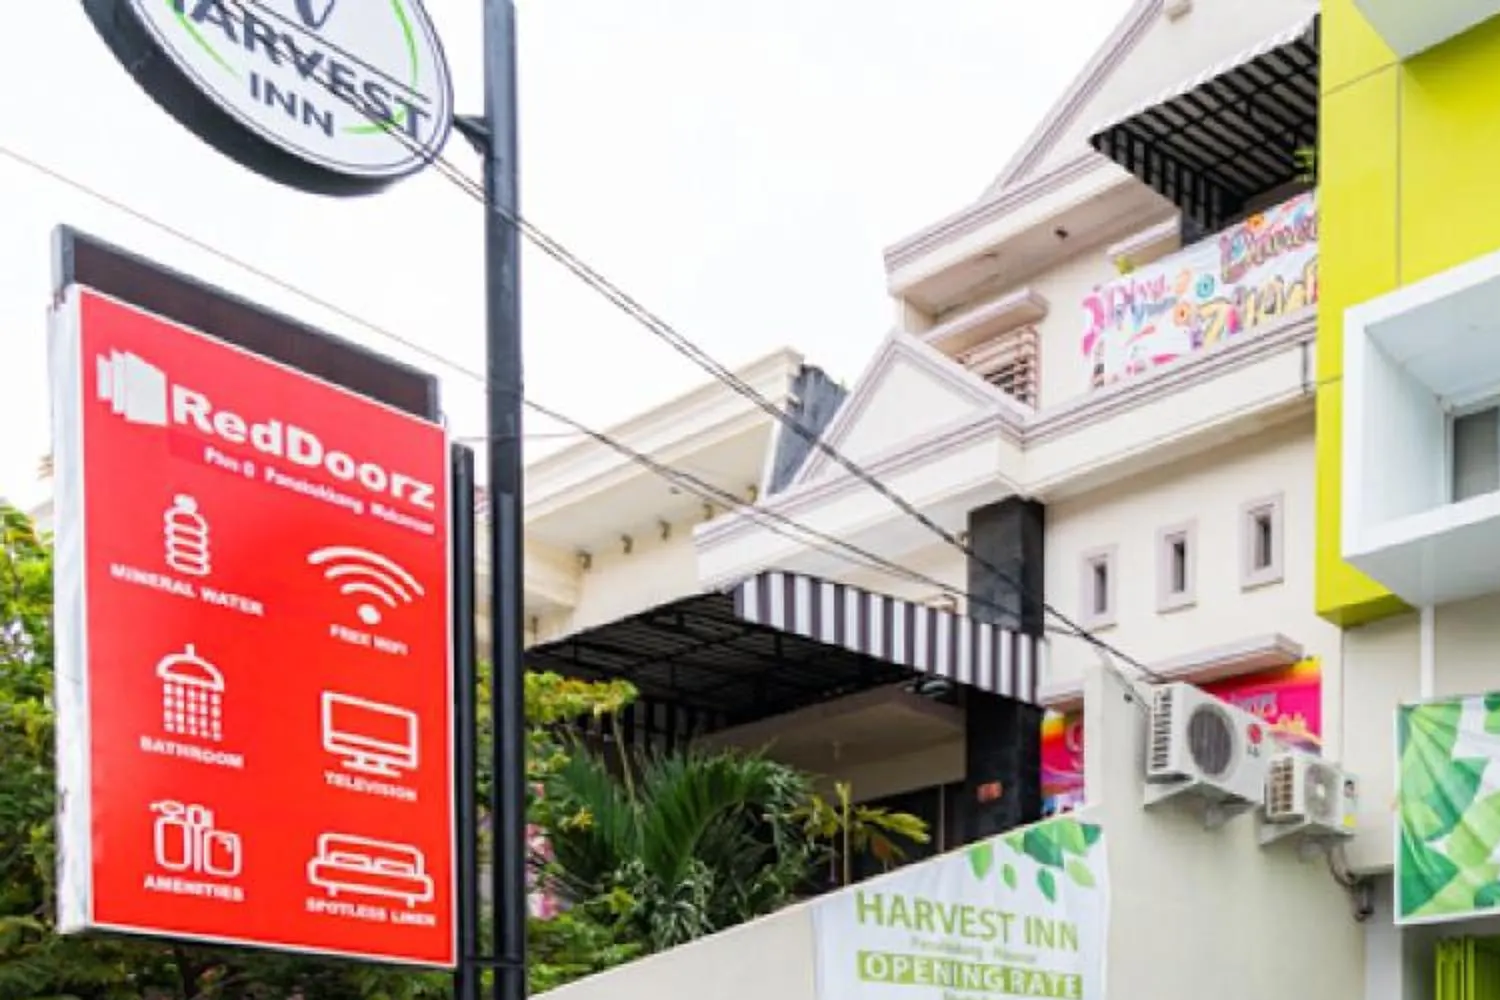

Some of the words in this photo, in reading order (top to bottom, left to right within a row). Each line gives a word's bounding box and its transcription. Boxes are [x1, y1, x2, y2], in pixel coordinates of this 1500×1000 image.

[250, 71, 335, 138] INN
[172, 383, 436, 512] RedDoorz
[110, 562, 197, 599] MINERAL
[201, 586, 266, 617] WATER
[329, 623, 371, 647] FREE
[139, 735, 245, 769] BATHROOM
[323, 770, 418, 802] TELEVISION
[144, 874, 245, 902] AMENITIES
[305, 897, 387, 923] SPOTLESS
[855, 889, 1017, 944] HARVEST
[1024, 914, 1080, 952] INN
[865, 954, 1006, 992] OPENING
[1009, 971, 1081, 1000] RATE
